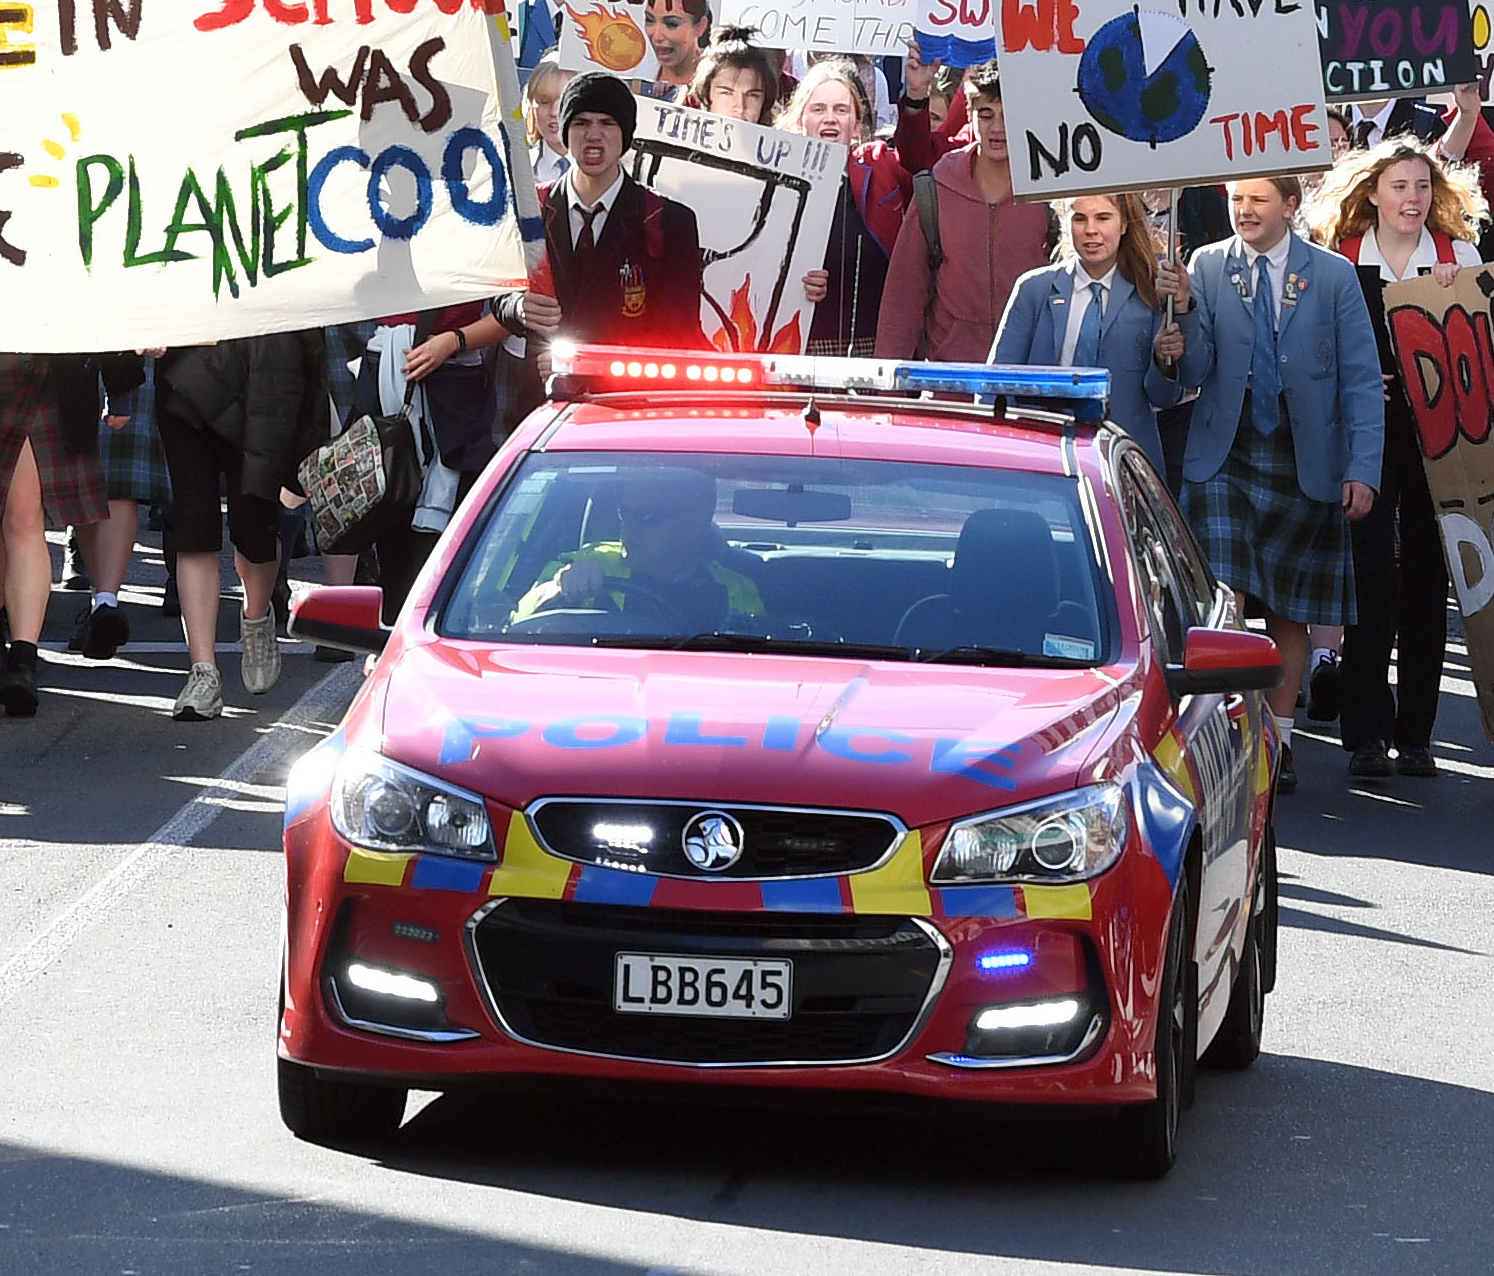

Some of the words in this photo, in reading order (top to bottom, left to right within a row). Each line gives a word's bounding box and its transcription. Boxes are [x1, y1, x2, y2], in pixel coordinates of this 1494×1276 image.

[289, 35, 453, 133] WAS
[1026, 121, 1103, 183] NO
[1210, 103, 1321, 162] TIME
[436, 709, 1030, 794] POLICE
[621, 959, 787, 1014] LBB645
